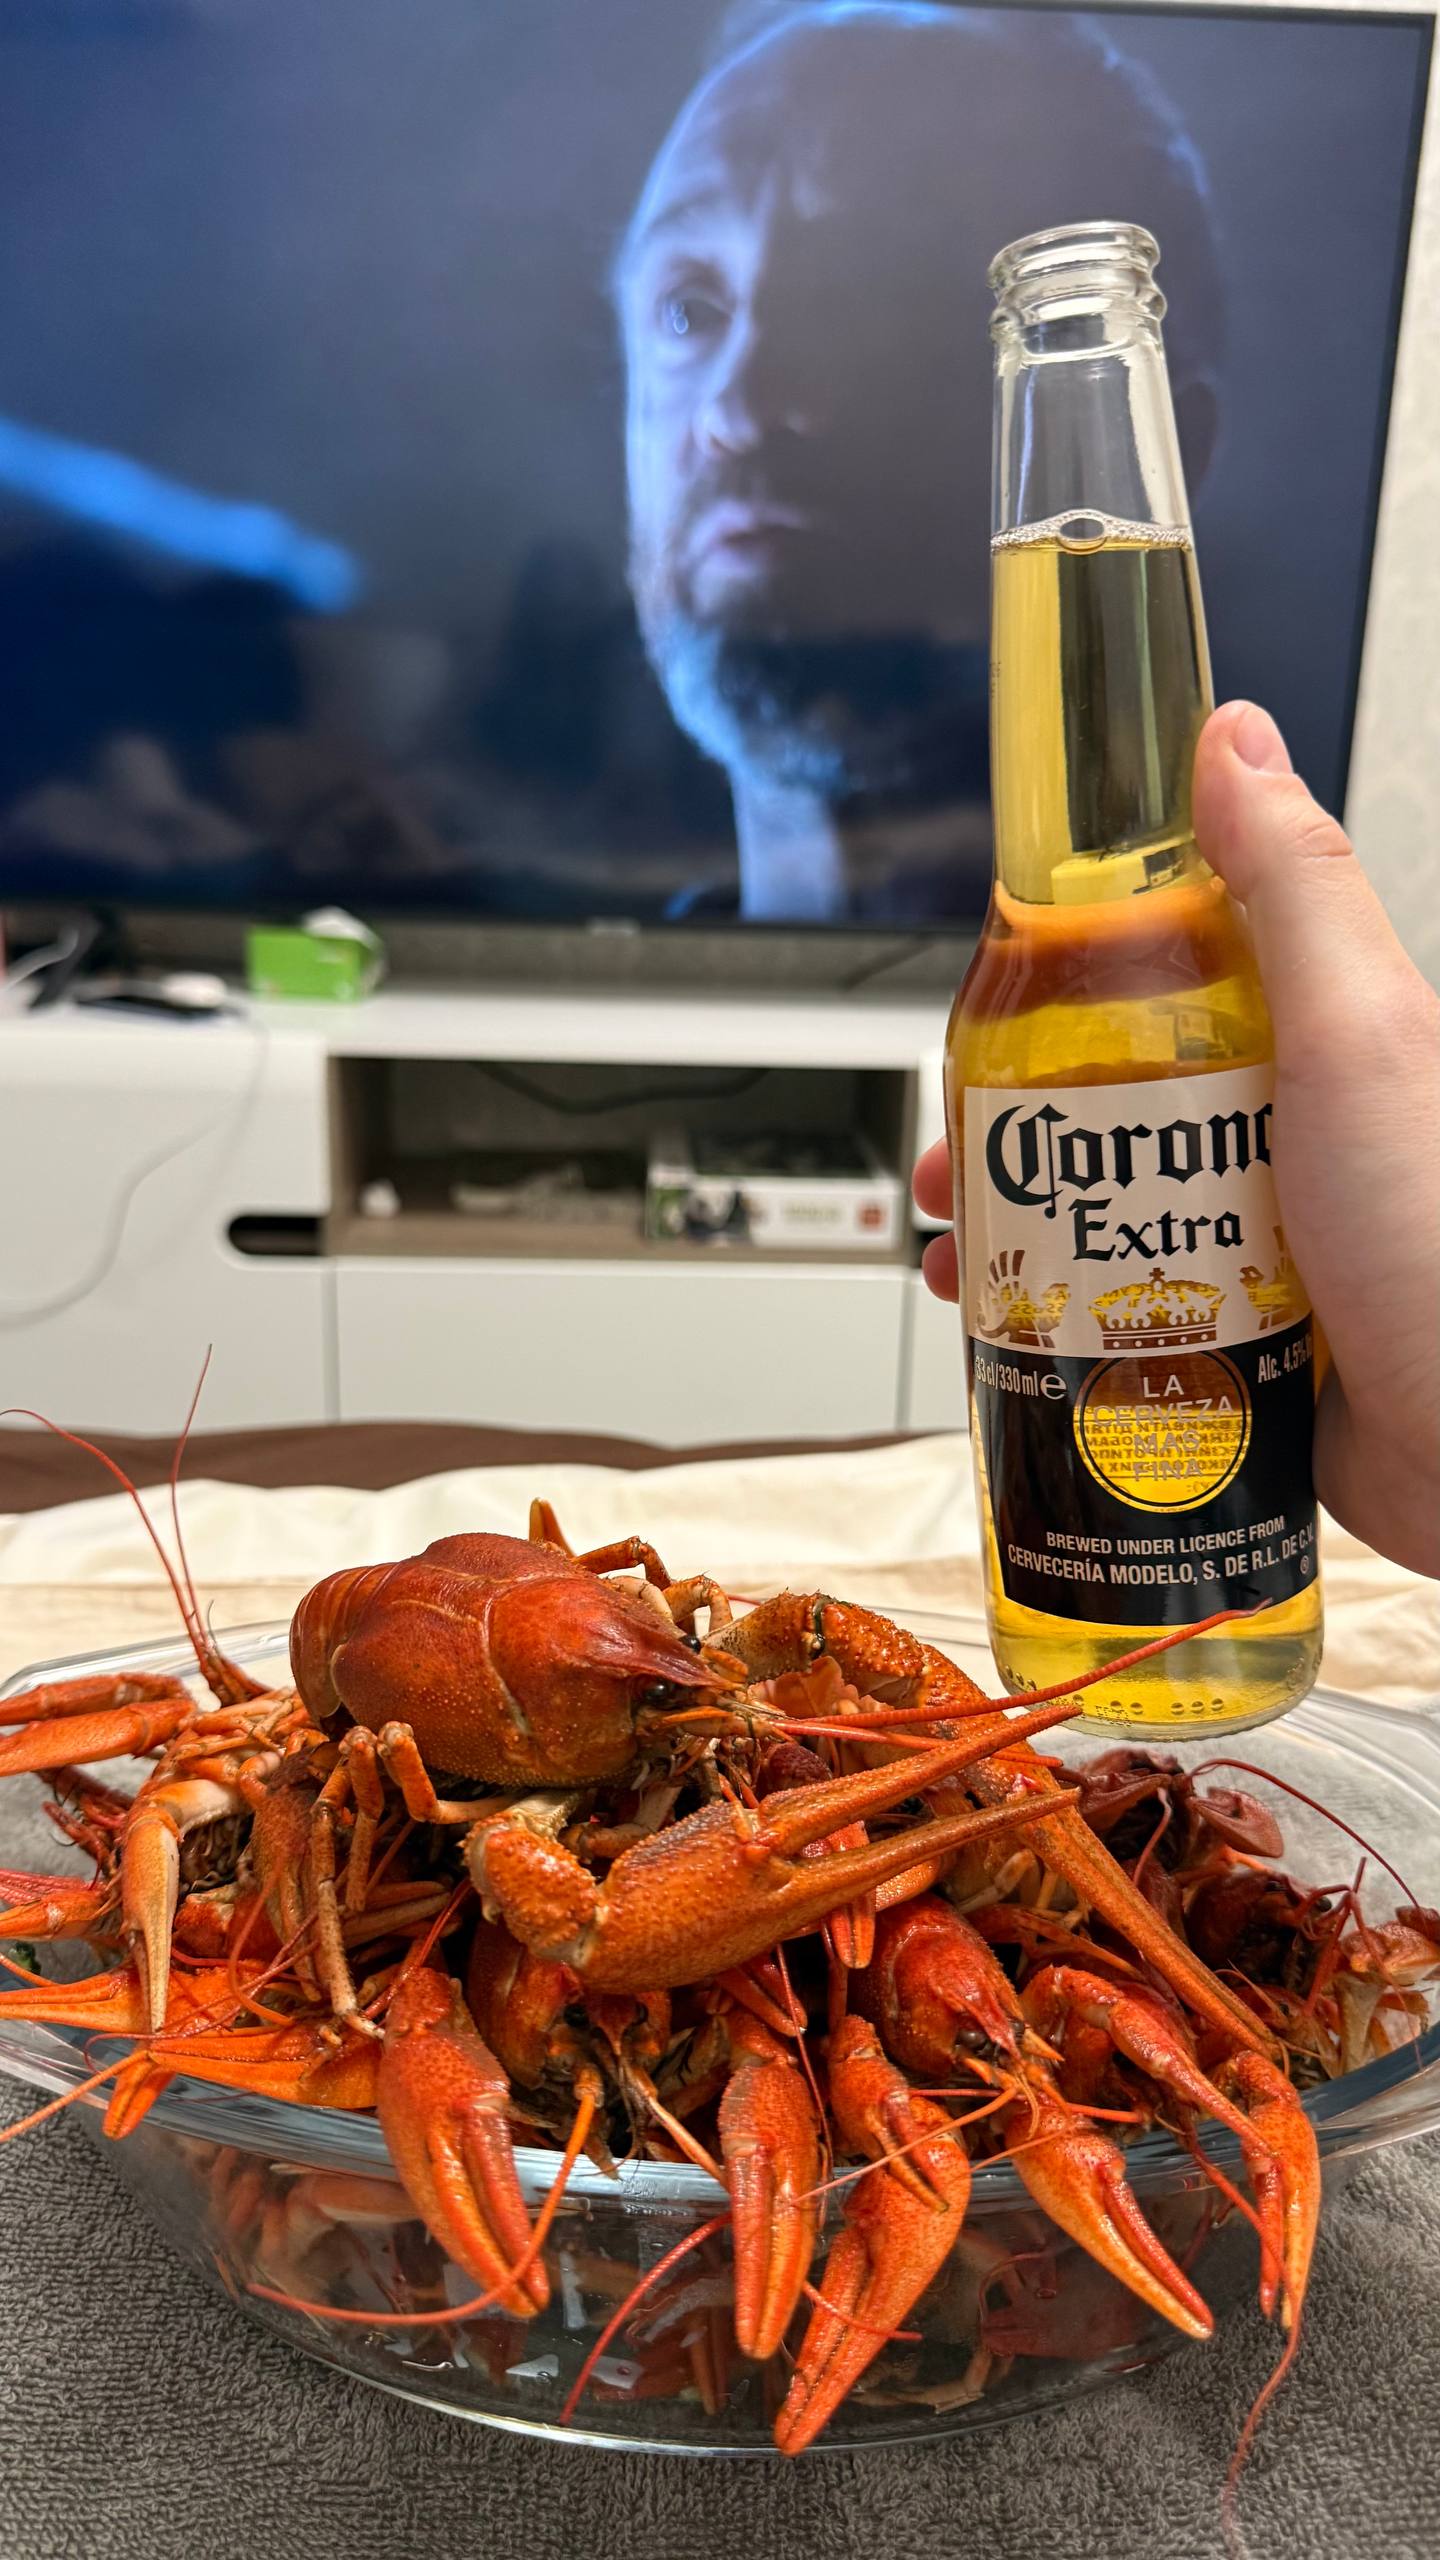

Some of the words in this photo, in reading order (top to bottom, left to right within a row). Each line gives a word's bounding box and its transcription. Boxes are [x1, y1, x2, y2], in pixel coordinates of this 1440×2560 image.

[1068, 1198, 1244, 1261] Extra
[1258, 1353, 1281, 1383] Alc.
[1143, 1374, 1185, 1398] LA
[1093, 1396, 1234, 1427] CERVEZA
[1132, 1429, 1201, 1455] MAS
[1133, 1459, 1203, 1482] FINA
[1046, 1531, 1112, 1554] BREWED
[1117, 1539, 1174, 1555] UNDER
[1180, 1528, 1245, 1553] LICENCE
[1249, 1515, 1285, 1541] FROM
[1007, 1543, 1105, 1583] CERVECERÍA
[1109, 1562, 1198, 1585] MODELO,
[1202, 1560, 1221, 1580] S.
[1225, 1554, 1248, 1577] DE
[1252, 1546, 1280, 1571] R.L.
[1281, 1535, 1297, 1559] DE
[1299, 1522, 1314, 1549] C.V.
